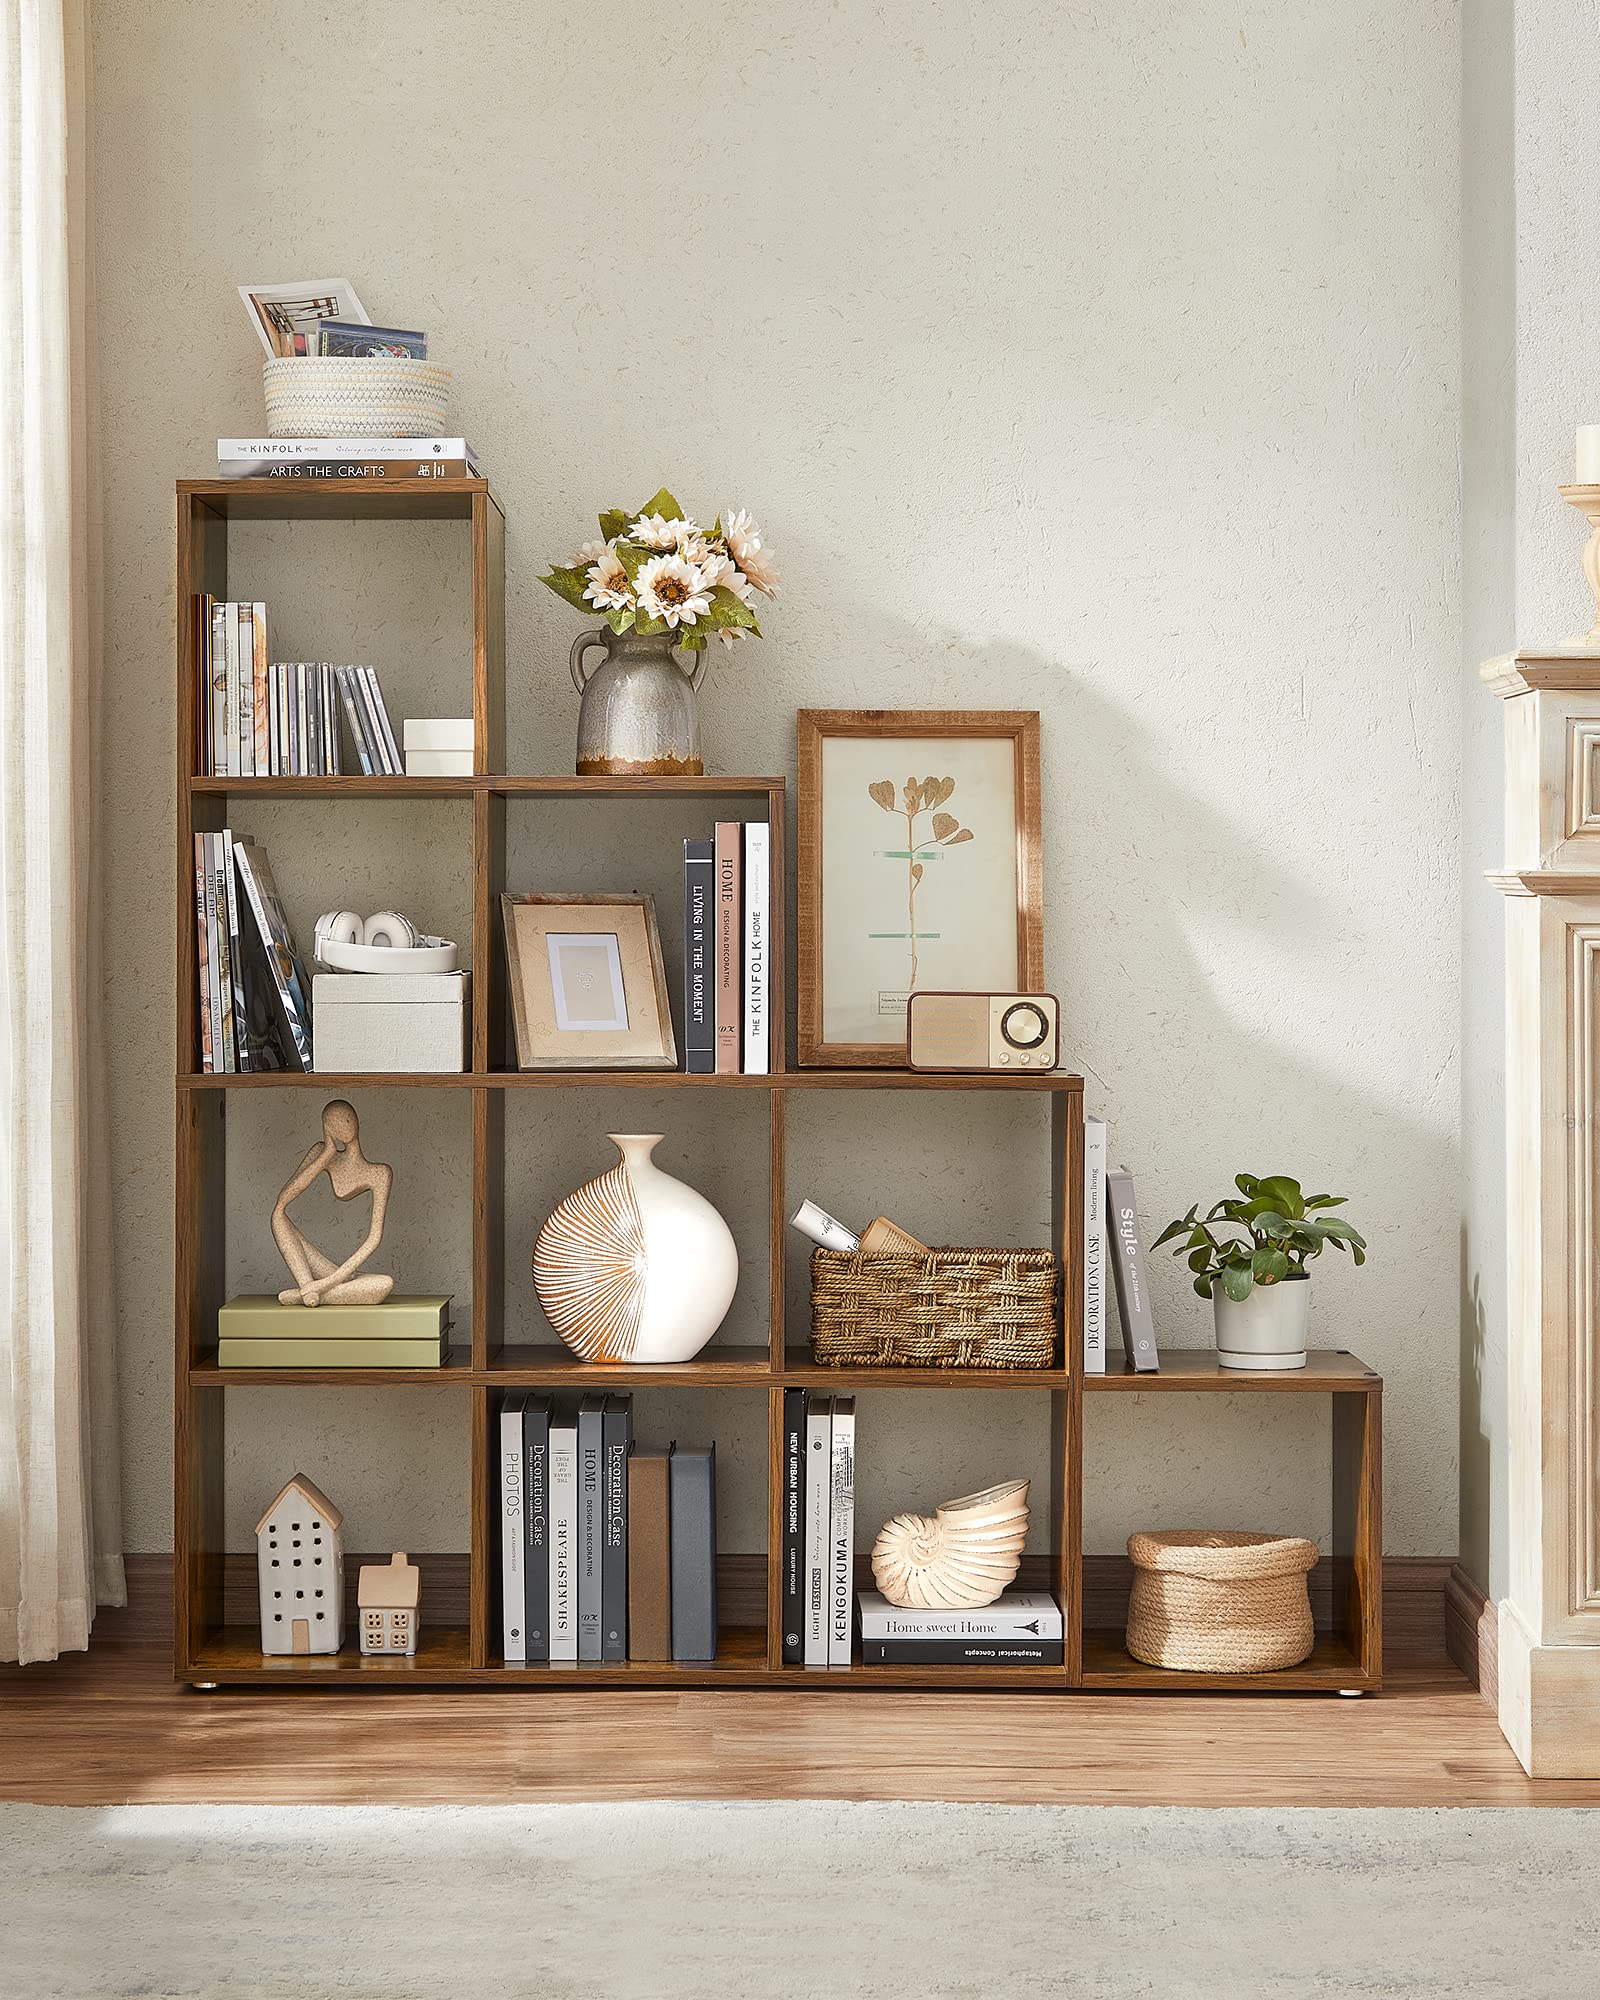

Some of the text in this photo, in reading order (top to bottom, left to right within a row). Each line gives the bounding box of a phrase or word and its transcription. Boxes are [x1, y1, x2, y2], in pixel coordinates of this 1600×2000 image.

[270, 466, 385, 477] ARTS THE CRAFTS
[247, 880, 259, 908] Without
[722, 859, 733, 902] HOME
[693, 885, 704, 1024] LIVING IN THE MOMENT
[751, 912, 761, 1037] THE KINFOLK HOME
[1090, 1168, 1099, 1190] living
[1088, 1234, 1099, 1265] CASE
[1120, 1208, 1138, 1255] Style
[1088, 1267, 1099, 1349] DECORATION
[506, 1453, 520, 1516] PHOTOS
[534, 1445, 545, 1546] Decoration Case
[585, 1449, 596, 1492] HOME
[612, 1445, 624, 1546] Decoration Case
[790, 1432, 798, 1533] NEW URBAN HOUSING
[558, 1519, 567, 1630] SHAKESPEARE
[835, 1538, 847, 1641] KENGOKUMA
[886, 1621, 997, 1633] Home sweet Home
